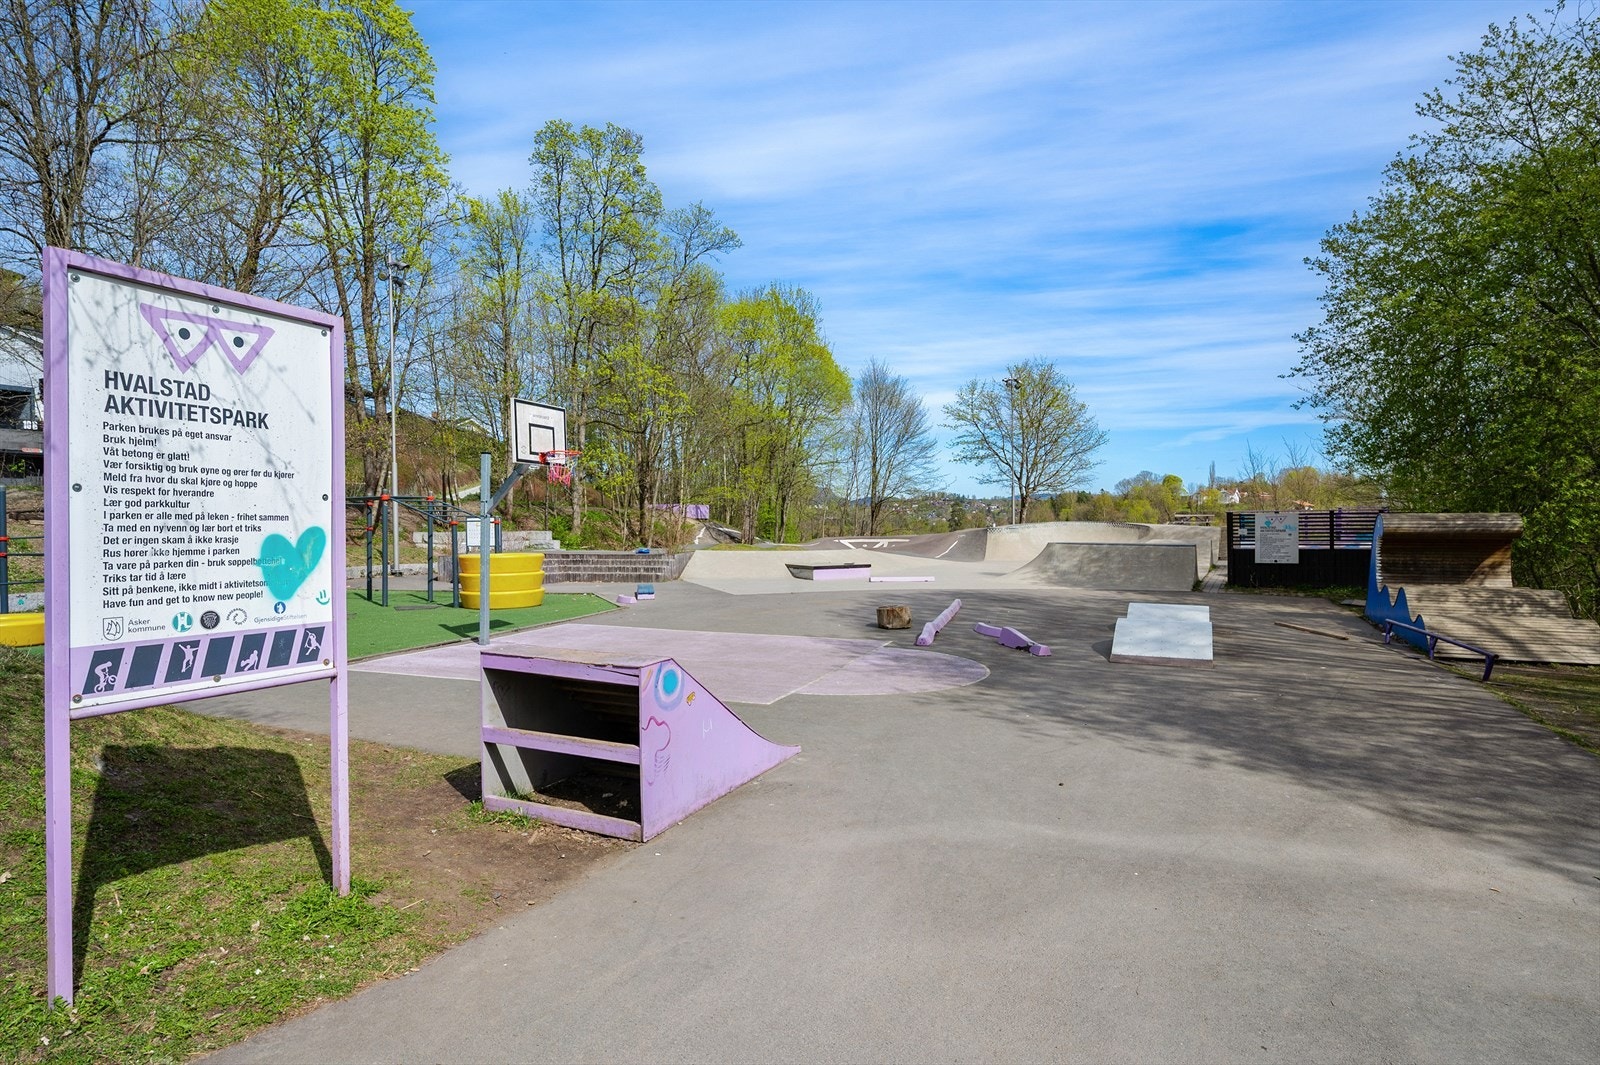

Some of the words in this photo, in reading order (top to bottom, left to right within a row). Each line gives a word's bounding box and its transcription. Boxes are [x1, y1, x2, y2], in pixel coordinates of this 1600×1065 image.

[104, 370, 210, 401] HVALSTAD
[104, 394, 269, 429] AKTIVITETSPARK
[103, 422, 135, 432] Parken
[139, 425, 169, 436] brukes
[172, 428, 182, 438] på
[185, 431, 203, 440] eget
[205, 431, 232, 441] ansvar
[103, 435, 126, 444] Bruk
[129, 437, 157, 446] hjelm!
[103, 447, 119, 456] Våt
[122, 447, 153, 460] betong
[168, 452, 190, 461] glatt!
[104, 460, 122, 469] Vær
[126, 461, 163, 472] forsiktig
[179, 465, 198, 473] bruk
[200, 467, 219, 475] øyne
[274, 470, 294, 479] kjører
[104, 473, 126, 481] Meld
[130, 474, 143, 482] fra
[145, 475, 165, 483] hvor
[168, 475, 178, 484] du
[181, 476, 198, 485] skal
[200, 478, 220, 487] kjøre
[223, 480, 232, 488] og
[235, 479, 257, 488] hoppe
[104, 486, 118, 494] Vis
[121, 486, 156, 496] respekt
[173, 489, 214, 497] hverandre
[104, 498, 122, 507] Lær
[125, 499, 141, 508] god
[144, 500, 190, 508] parkkultur
[110, 512, 142, 522] parken
[195, 512, 205, 521] på
[237, 513, 257, 521] frihet
[104, 524, 113, 532] Ta
[117, 524, 137, 532] med
[154, 525, 165, 534] ny
[190, 525, 199, 534] og
[217, 524, 232, 532] bort
[134, 536, 159, 547] ingen
[188, 535, 192, 544] å
[215, 536, 239, 545] krasje
[151, 548, 169, 556] ikke
[172, 548, 205, 558] hjemme
[213, 548, 239, 557] parken
[103, 562, 113, 570] Ta
[139, 560, 150, 570] på
[153, 560, 183, 570] parken
[103, 574, 126, 582] Triks
[145, 572, 156, 580] tid
[160, 572, 165, 580] å
[103, 587, 119, 596] Sitt
[122, 587, 133, 597] på
[136, 585, 176, 595] benkene,
[179, 584, 197, 592] ikke
[200, 582, 218, 591] midt
[103, 600, 126, 608] Have
[129, 598, 144, 607] fun
[147, 597, 163, 606] and
[166, 596, 179, 606] get
[182, 595, 190, 603] to
[193, 594, 215, 602] know
[217, 593, 234, 601] new
[236, 591, 263, 602] people!
